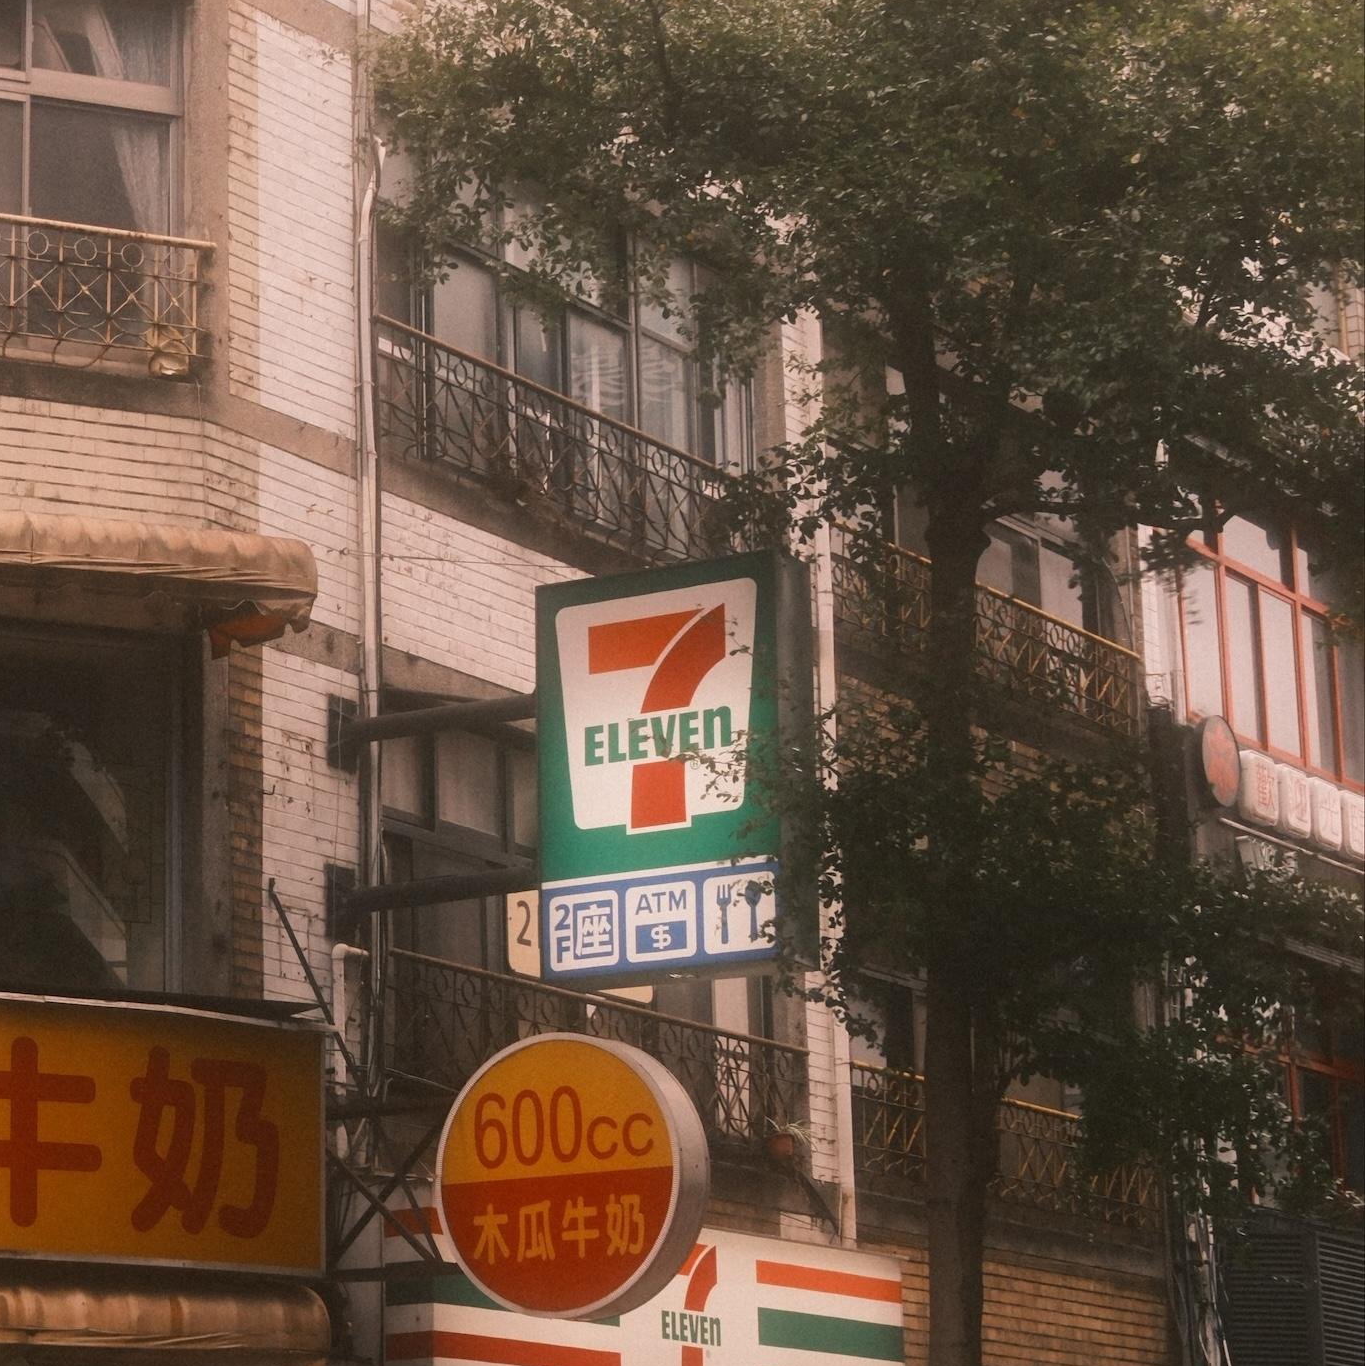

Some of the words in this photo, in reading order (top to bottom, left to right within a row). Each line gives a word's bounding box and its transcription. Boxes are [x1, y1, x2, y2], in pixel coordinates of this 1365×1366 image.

[635, 889, 687, 915] ATM
[473, 1085, 655, 1170] 600cc
[472, 1193, 646, 1265] 木瓜牛奶
